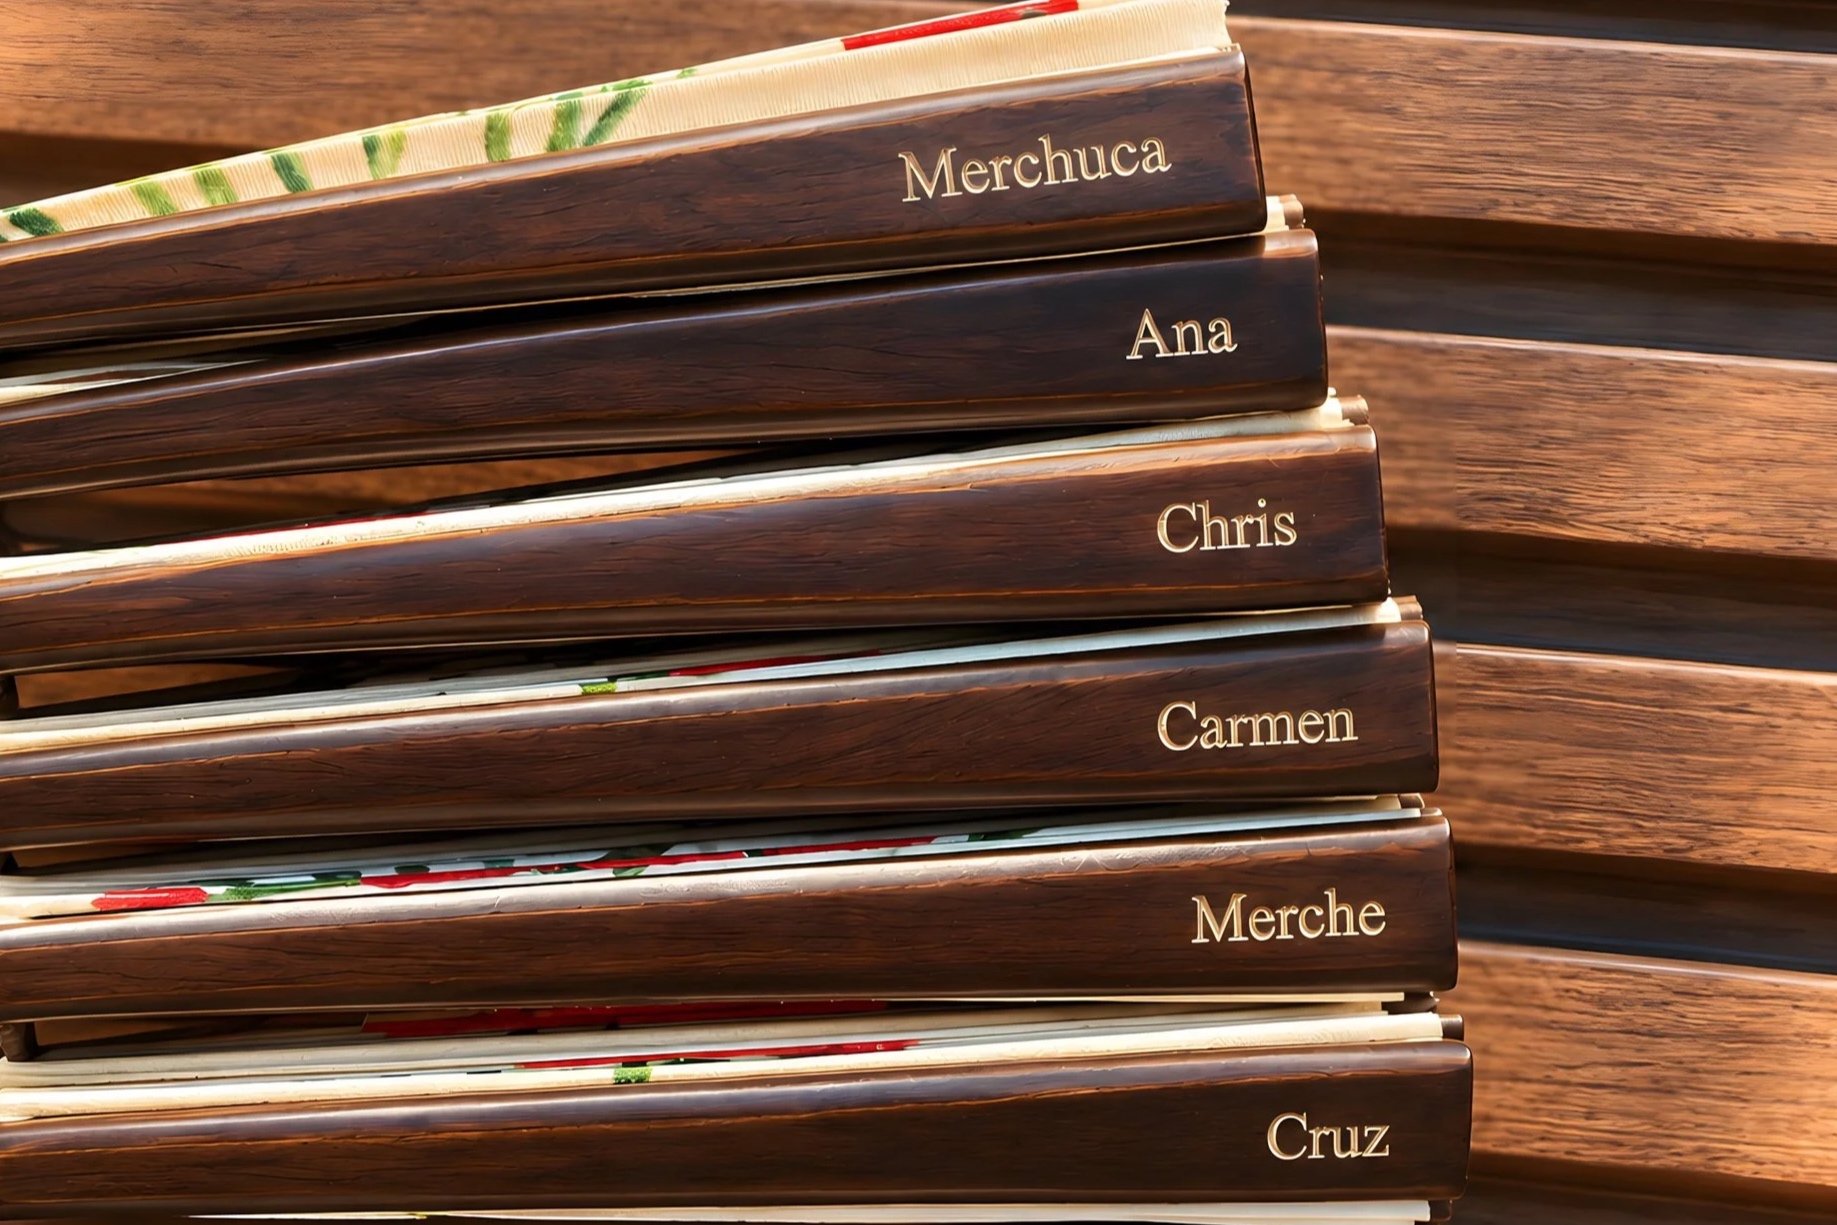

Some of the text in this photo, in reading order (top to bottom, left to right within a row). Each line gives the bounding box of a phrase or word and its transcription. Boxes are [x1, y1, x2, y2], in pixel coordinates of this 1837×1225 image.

[898, 134, 1172, 202] Merchuca
[1126, 309, 1237, 360] Ana
[1157, 499, 1298, 553] Chris
[1158, 701, 1358, 752] Carmen
[1192, 888, 1386, 943] Merche
[1267, 1112, 1390, 1160] Cruz
